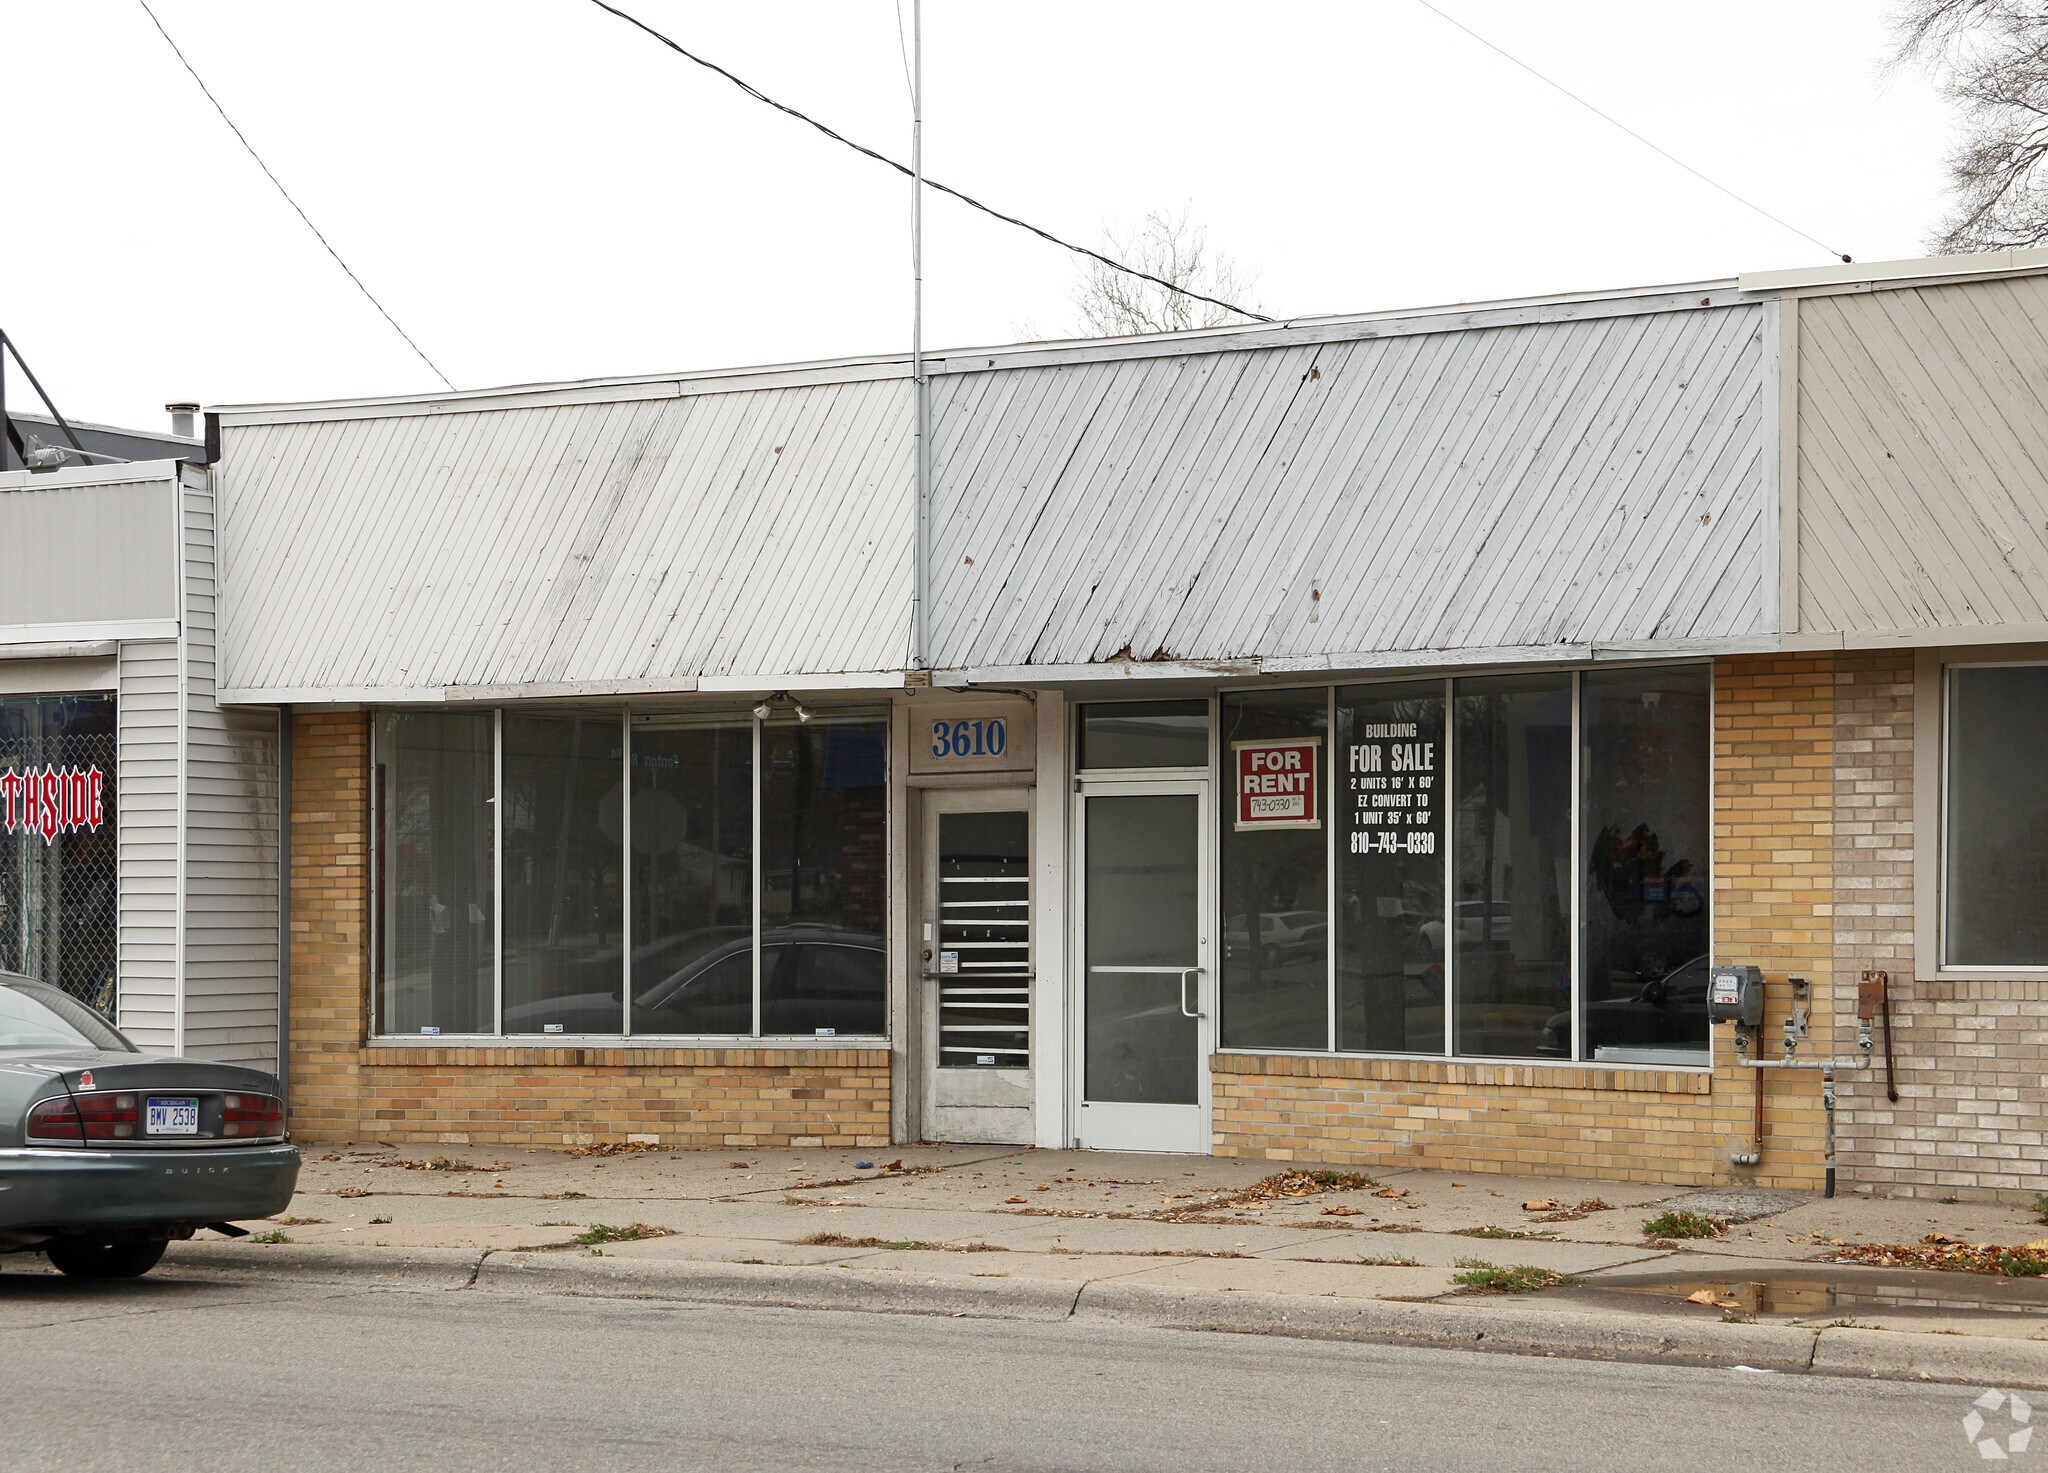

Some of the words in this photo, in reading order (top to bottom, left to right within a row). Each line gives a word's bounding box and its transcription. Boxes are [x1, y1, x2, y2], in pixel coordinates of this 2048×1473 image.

[933, 720, 1005, 757] 3610
[1366, 723, 1417, 738] BUILDING
[1251, 750, 1301, 771] FOR
[1350, 745, 1382, 772] FOR
[1391, 743, 1434, 771] SALE
[1244, 773, 1310, 794] RENT
[1350, 778, 1357, 790] 2
[1360, 777, 1387, 789] UNITS
[1391, 777, 1404, 789] 16'
[1408, 777, 1415, 789] X
[1419, 776, 1434, 788] 60'
[1252, 799, 1290, 812] 743-0330
[1358, 795, 1368, 807] EZ
[1372, 794, 1412, 807] CONVERT
[1416, 794, 1428, 806] TO
[1354, 812, 1359, 824] 1
[1363, 812, 1383, 824] UNIT
[1387, 811, 1402, 824] 35'
[1416, 811, 1431, 824] 60'
[1351, 832, 1435, 854] 810-743-0330
[150, 1108, 167, 1126] BMV
[173, 1108, 196, 1126] 2538
[165, 1166, 230, 1175] BUICK
